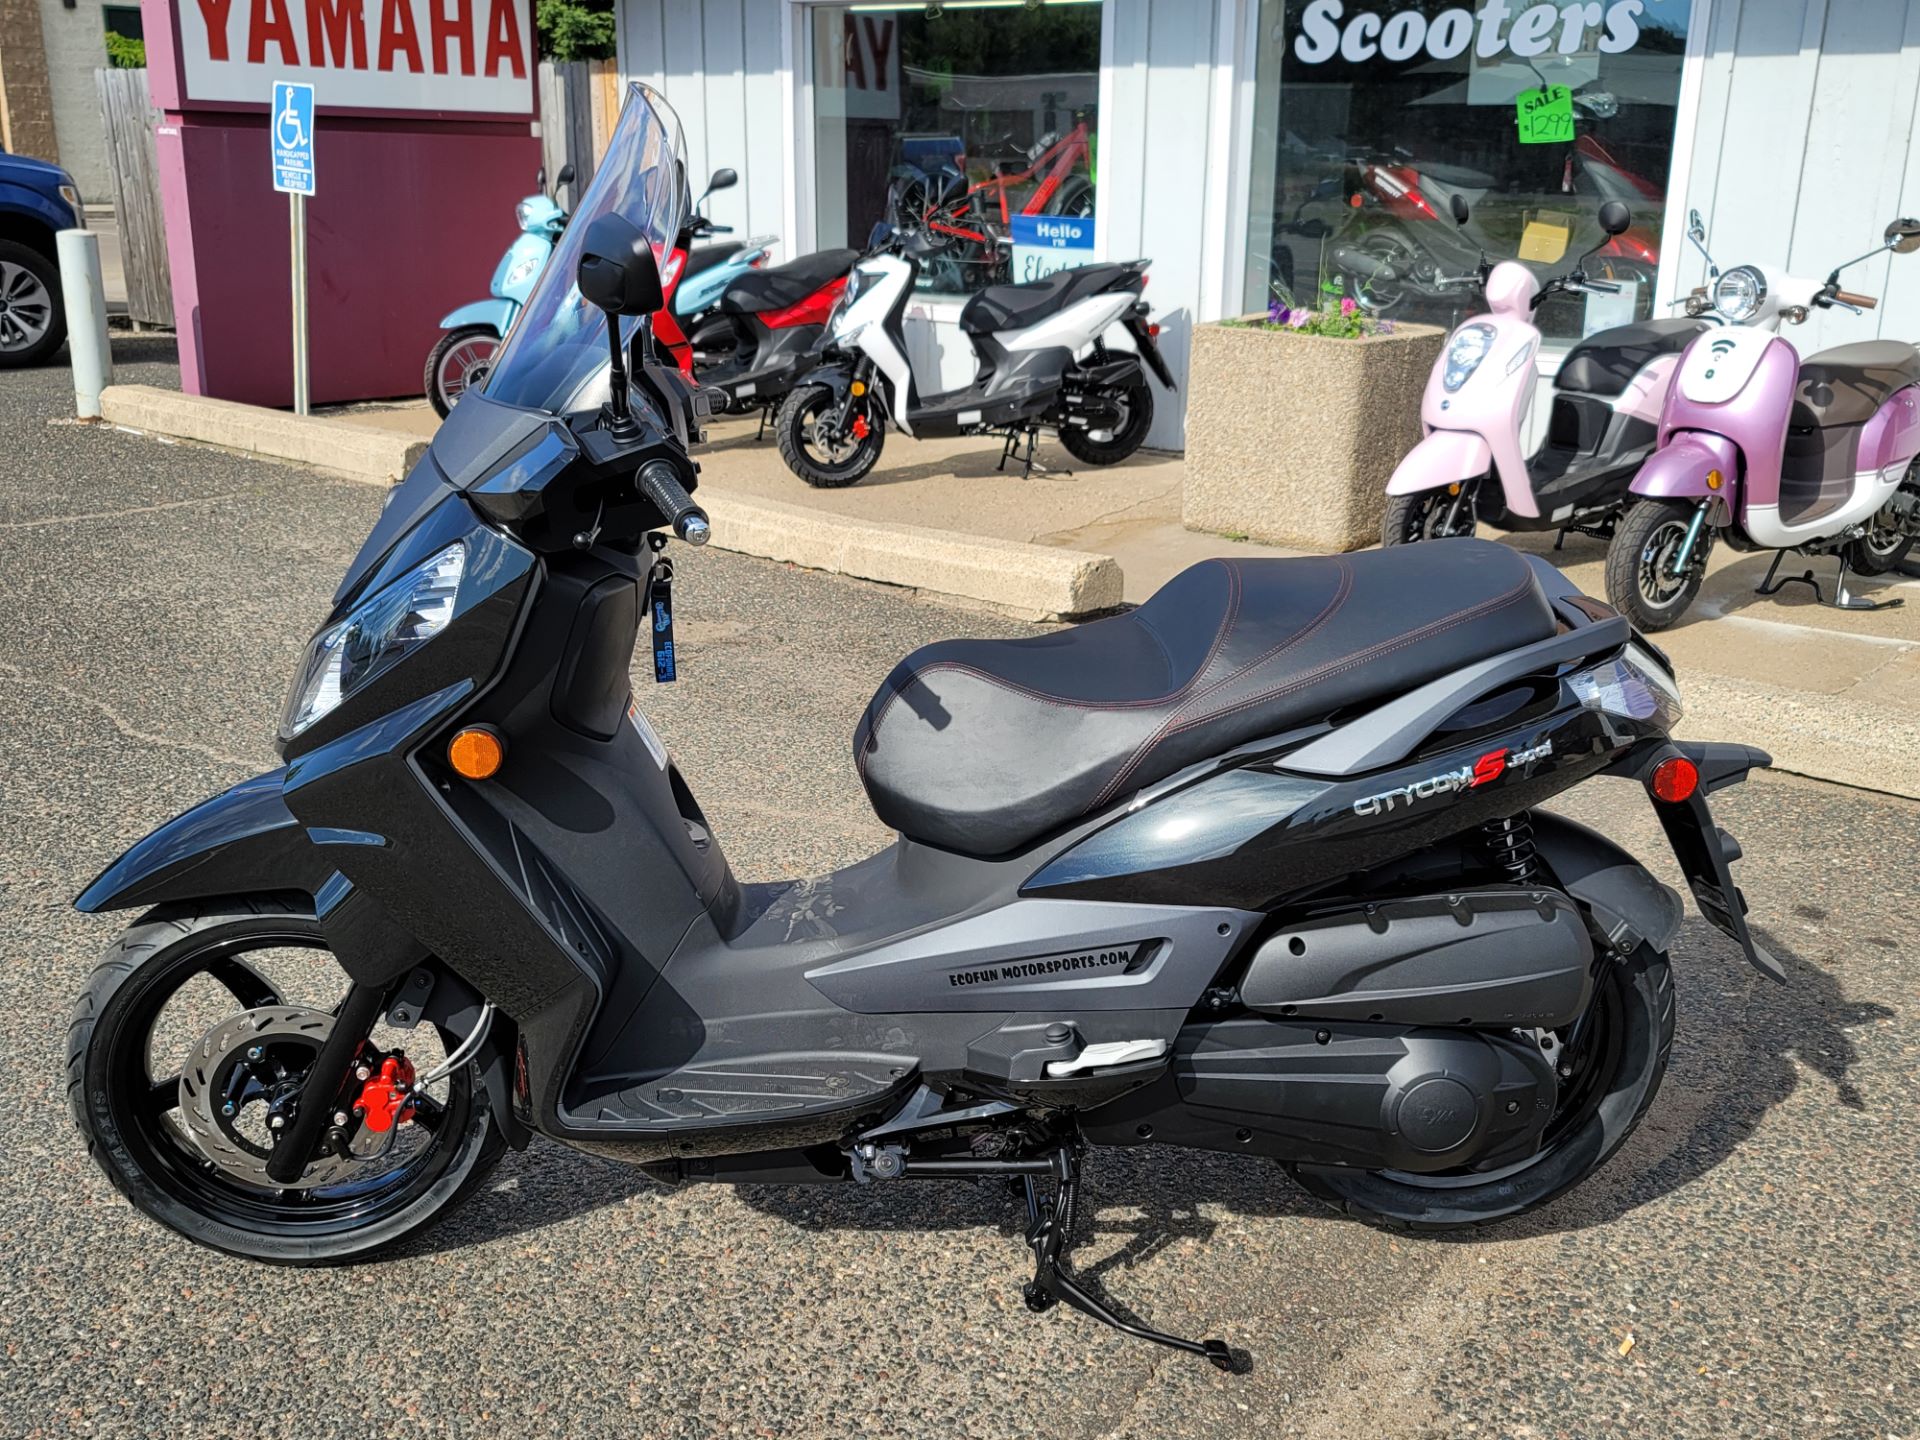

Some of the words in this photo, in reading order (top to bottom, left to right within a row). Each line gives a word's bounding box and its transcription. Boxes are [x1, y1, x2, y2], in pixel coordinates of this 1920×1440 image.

[199, 0, 527, 79] YAMAHA
[1294, 0, 1645, 64] Scooters
[1524, 86, 1564, 114] SALE
[1036, 222, 1082, 239] Hello
[949, 968, 999, 987] ECOFUN
[1002, 950, 1131, 980] MOTORSPORTS.COM
[94, 1090, 140, 1178] MAXXIS
